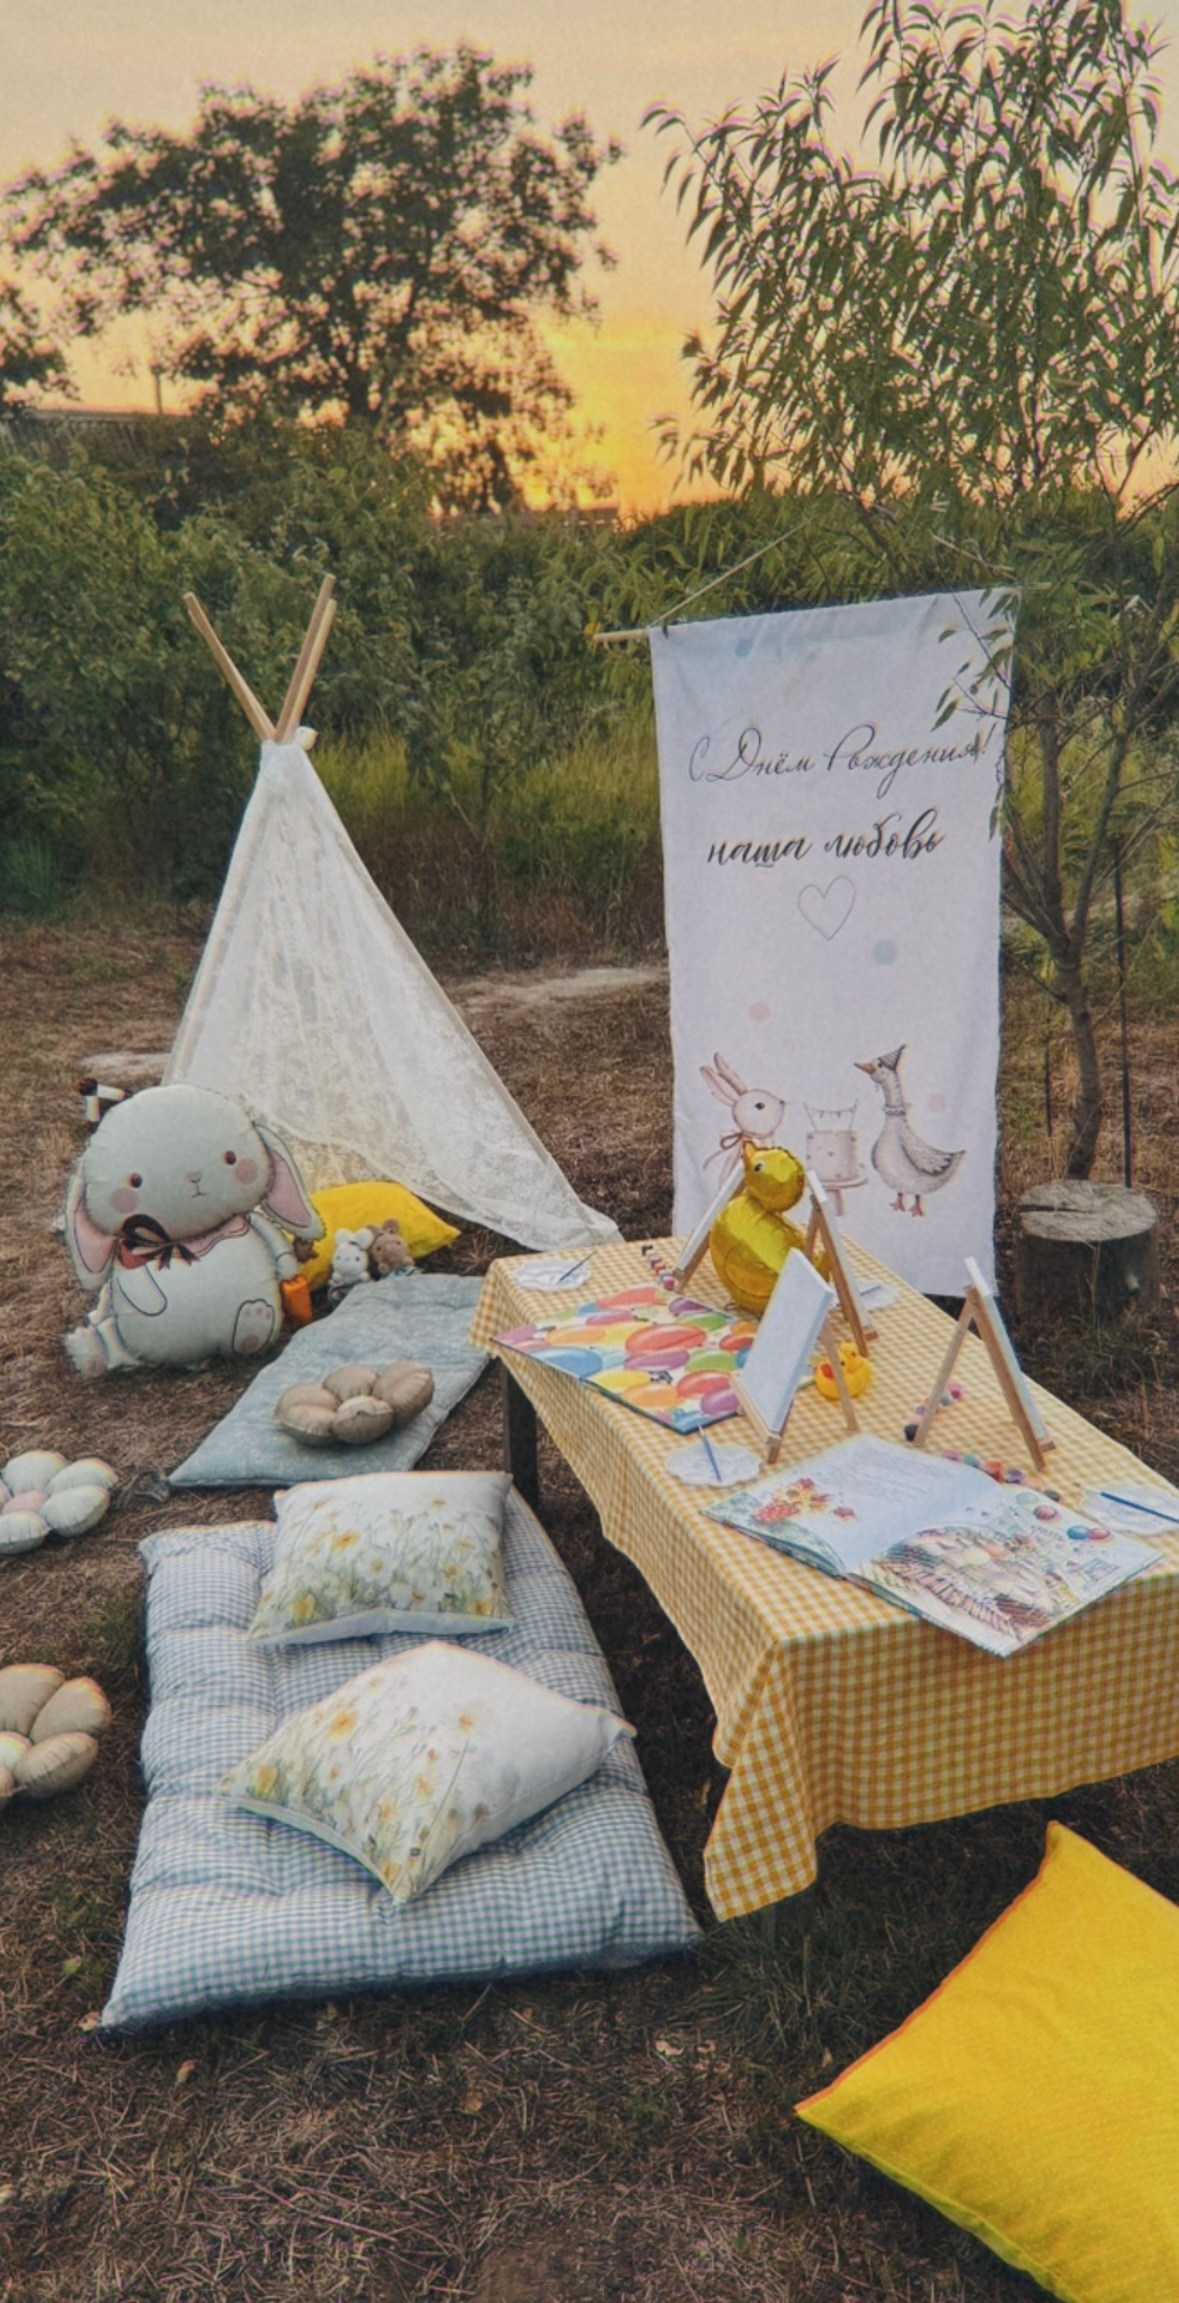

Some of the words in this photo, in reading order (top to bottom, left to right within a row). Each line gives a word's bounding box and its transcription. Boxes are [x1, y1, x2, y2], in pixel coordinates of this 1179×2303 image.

[688, 735, 711, 782] С
[705, 726, 815, 783] Днём
[706, 834, 812, 869] наша
[823, 807, 945, 860] любовь
